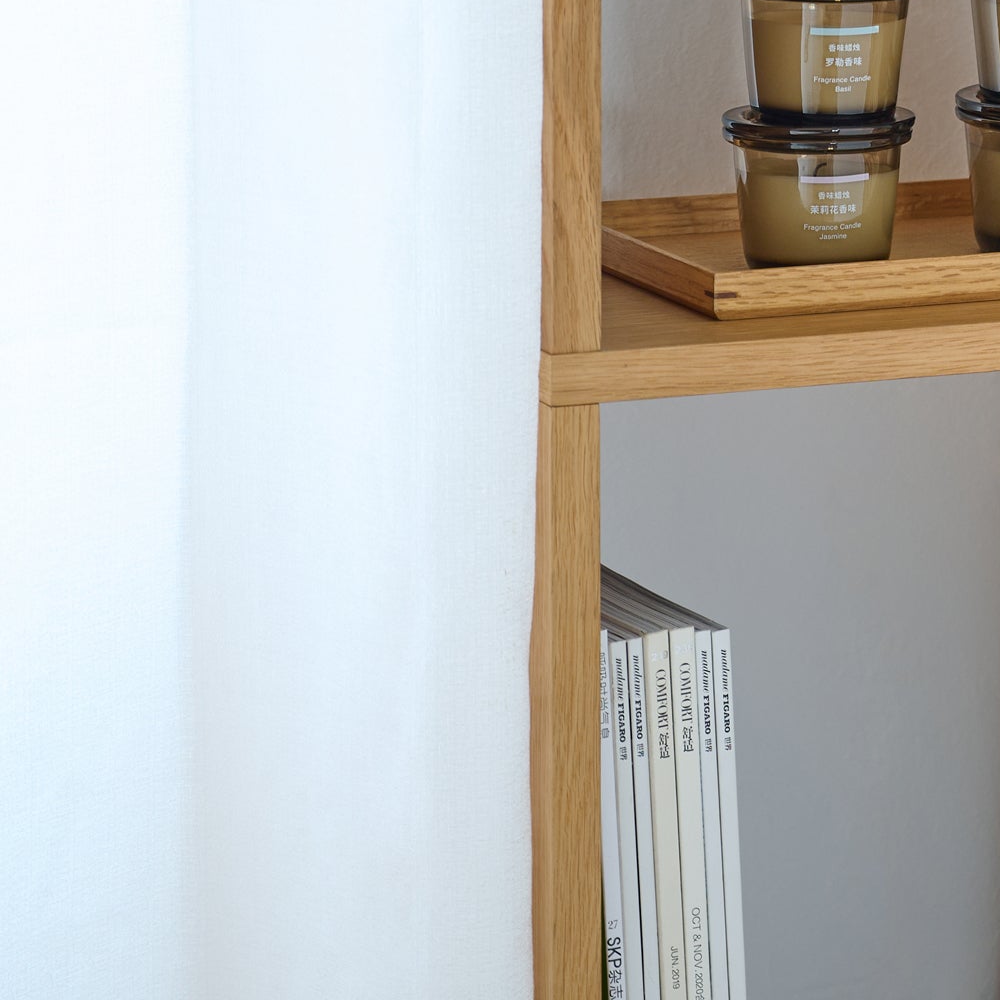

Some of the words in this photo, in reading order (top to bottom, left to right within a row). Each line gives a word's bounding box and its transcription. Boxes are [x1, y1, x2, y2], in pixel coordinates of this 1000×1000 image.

[813, 75, 848, 84] Fragrance
[849, 74, 871, 82] Candle
[825, 57, 862, 67] 罗勒香味
[803, 223, 838, 231] Fragrance
[839, 222, 862, 230] Candle
[810, 204, 857, 215] 茉莉花香味
[615, 658, 625, 700] madame
[632, 655, 642, 698] madame
[700, 650, 711, 693] madame
[720, 649, 730, 691] madame
[655, 669, 669, 729] COMFORT
[679, 662, 693, 722] COMFORT
[617, 702, 626, 743] FIGARO
[634, 700, 644, 740] FIGARO
[703, 695, 712, 735] FIGARO
[722, 693, 731, 733] FIGARO
[608, 920, 618, 930] 27
[691, 907, 701, 930] OCT
[693, 934, 701, 943] &
[670, 946, 680, 990] JUN.2019
